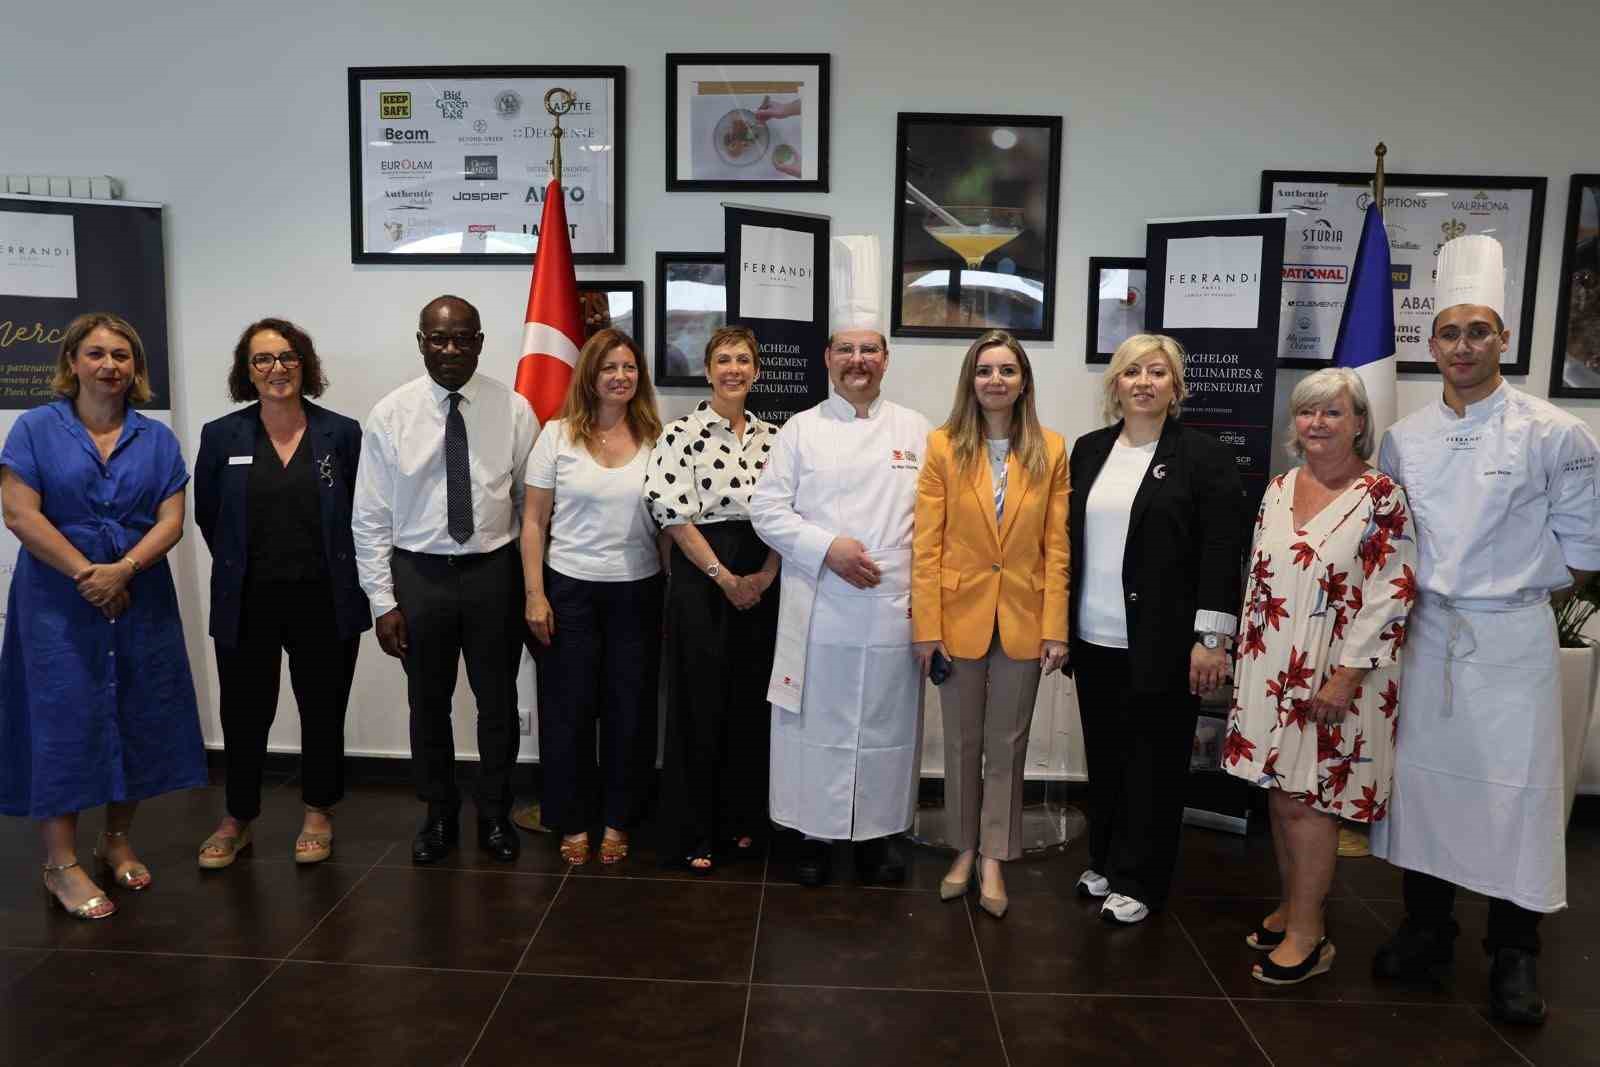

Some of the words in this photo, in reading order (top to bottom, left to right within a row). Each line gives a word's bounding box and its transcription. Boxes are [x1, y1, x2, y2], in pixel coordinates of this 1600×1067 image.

[383, 95, 409, 104] KEEP
[443, 90, 461, 100] Big
[435, 99, 469, 109] Green
[383, 105, 409, 116] SAFE
[442, 108, 464, 120] Egg
[385, 127, 429, 140] Beam
[381, 159, 433, 170] EUROLAM
[452, 191, 510, 201] Josper
[1451, 199, 1510, 211] VALRHONA
[1302, 228, 1343, 243] STURIA
[743, 262, 812, 279] FERRANDI
[1169, 273, 1257, 285] FERRANDI
[1397, 324, 1422, 334] mic
[1396, 334, 1422, 344] ices
[758, 343, 801, 354] ACHELOR
[759, 357, 809, 368] NAGEMENT
[1254, 368, 1264, 380] &
